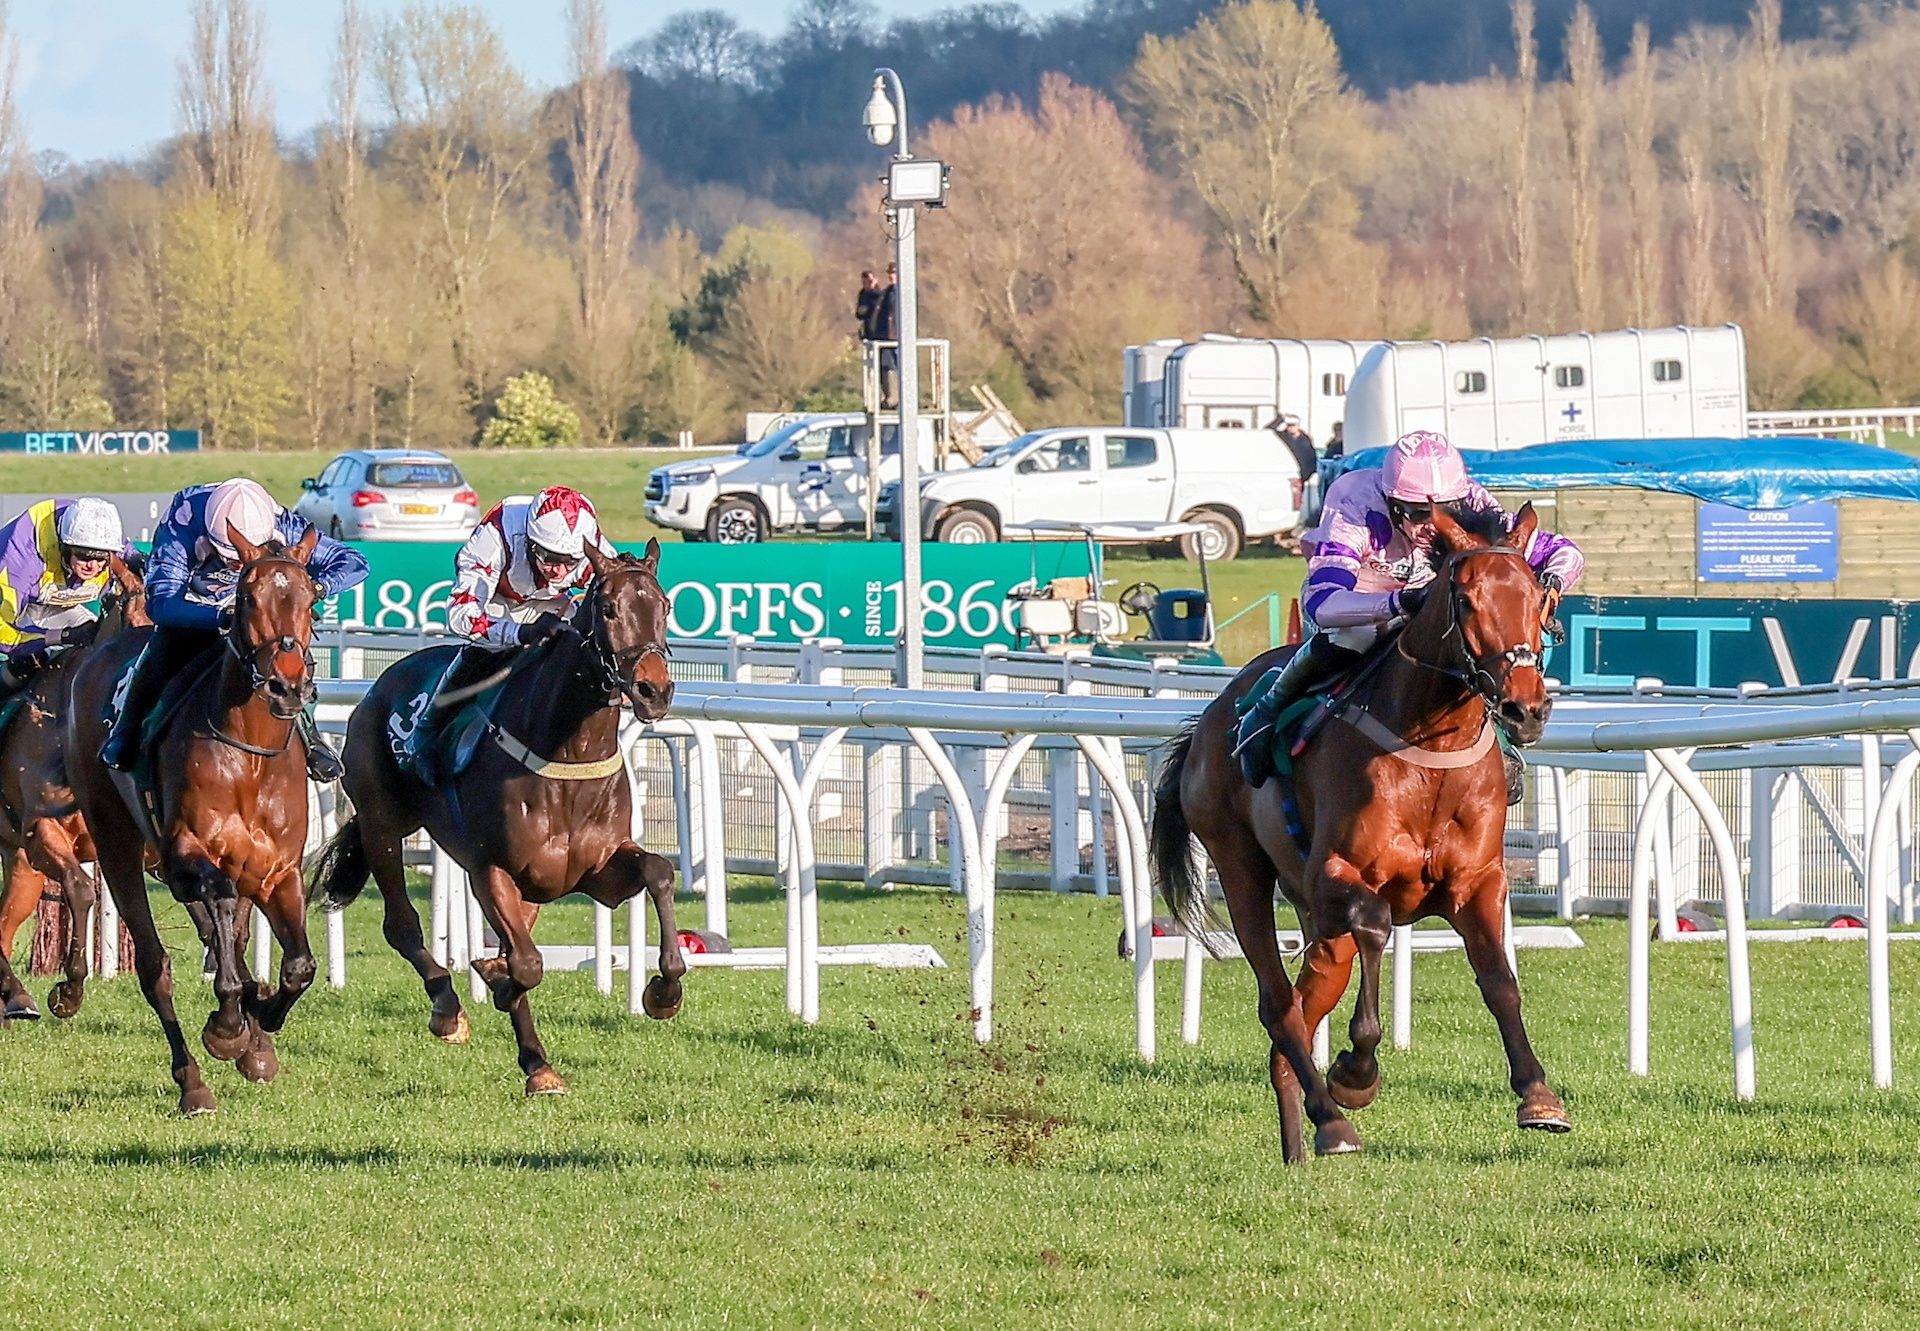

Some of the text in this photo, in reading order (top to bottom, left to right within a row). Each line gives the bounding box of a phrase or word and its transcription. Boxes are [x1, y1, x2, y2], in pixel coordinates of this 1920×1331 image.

[25, 431, 170, 455] BETVICTOR
[1748, 512, 1789, 521] CAUTION
[1740, 554, 1797, 564] PLEASE NOTE
[323, 593, 339, 624] INC
[341, 579, 456, 629] 186
[865, 580, 882, 637] SINCE
[1541, 613, 1920, 689] ETVI
